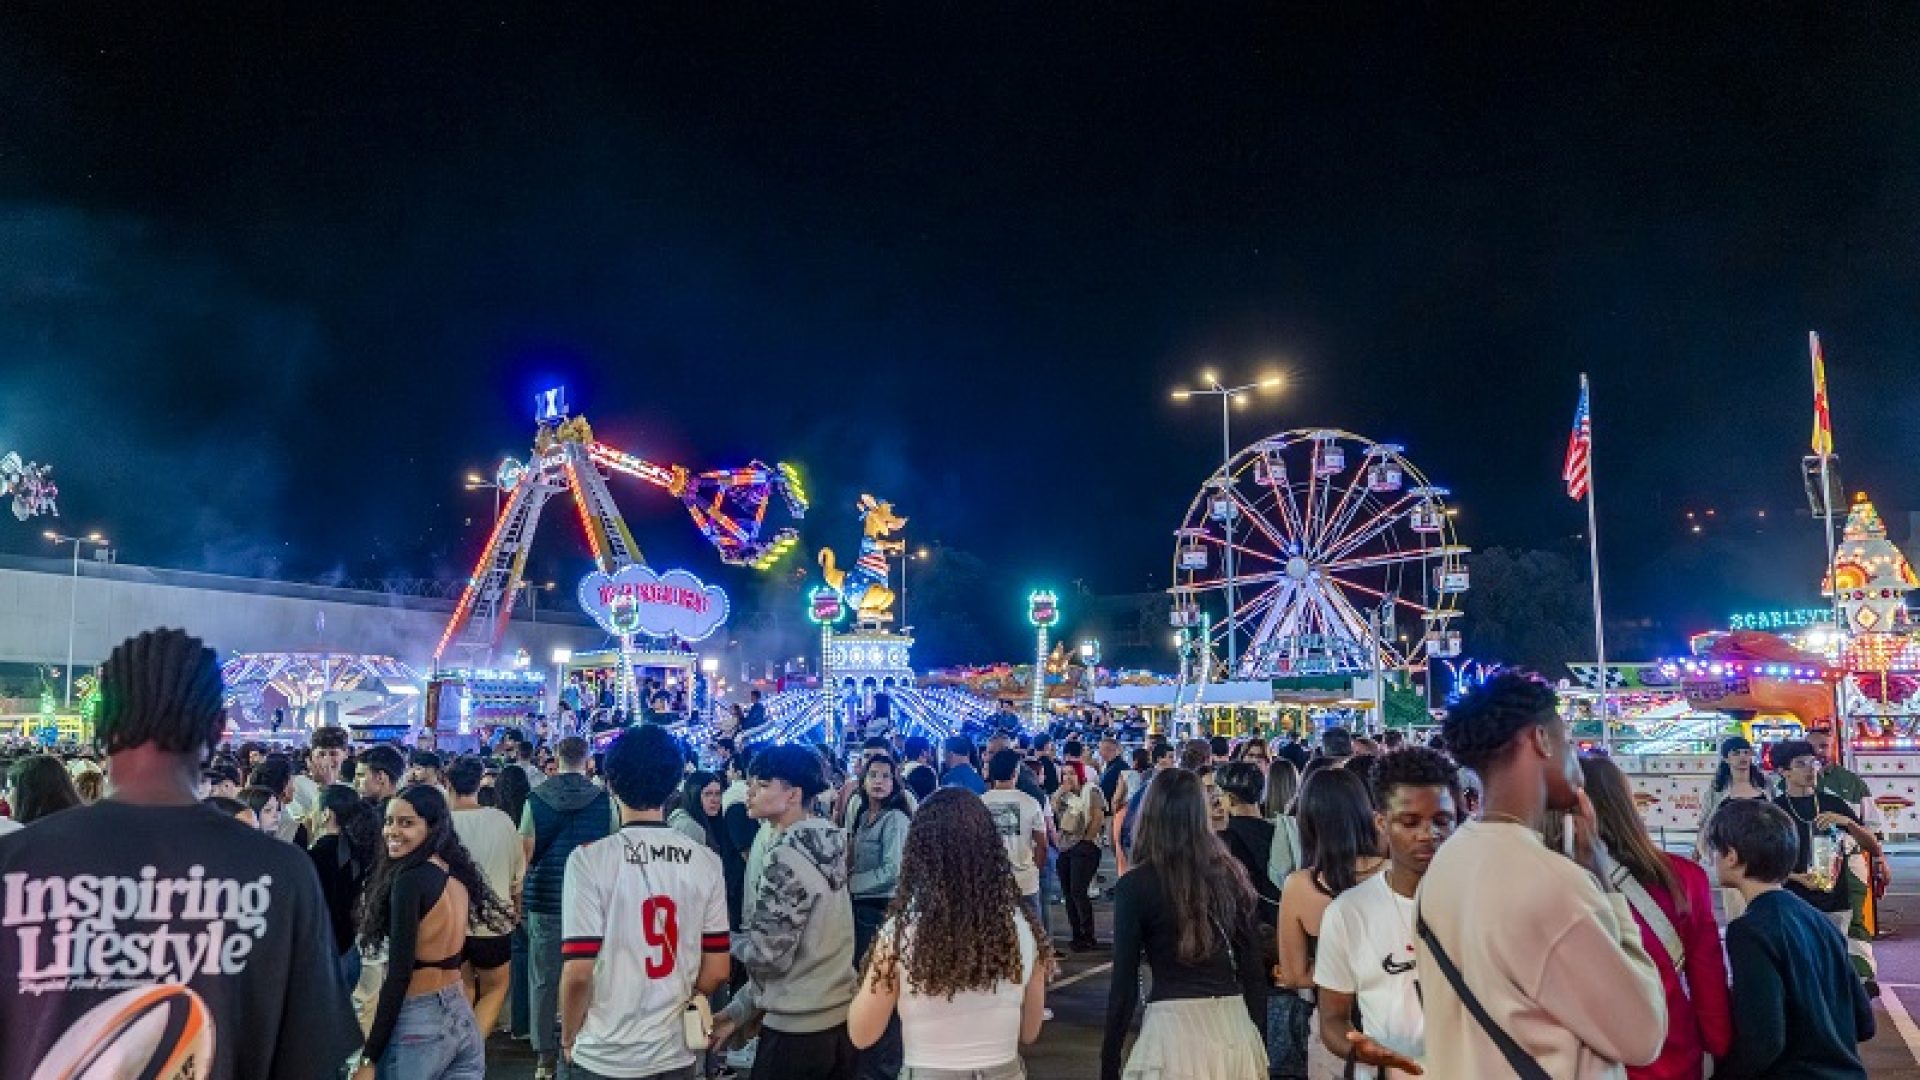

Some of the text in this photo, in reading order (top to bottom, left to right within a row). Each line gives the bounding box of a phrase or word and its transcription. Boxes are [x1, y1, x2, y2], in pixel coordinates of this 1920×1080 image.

[650, 844, 692, 864] MRV
[3, 864, 272, 938] Inspiring
[17, 919, 253, 985] Lifestyle
[641, 895, 679, 979] 9
